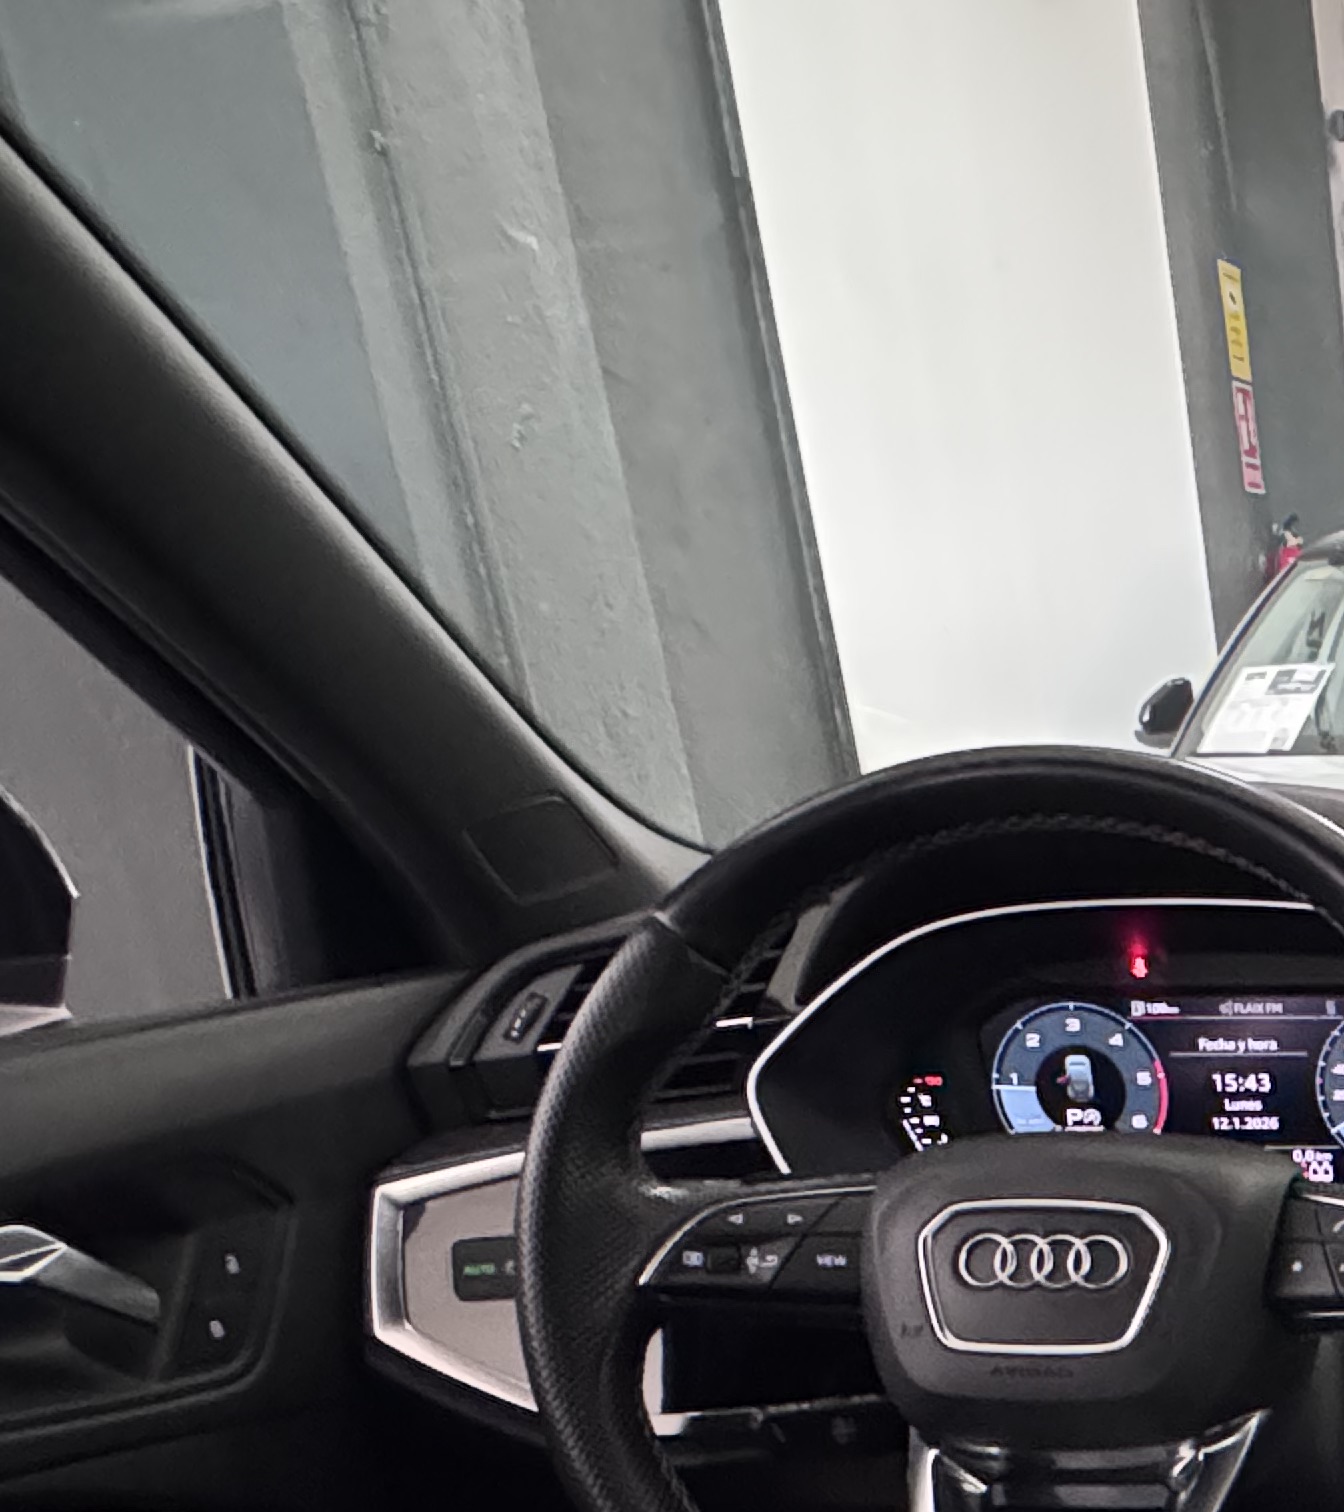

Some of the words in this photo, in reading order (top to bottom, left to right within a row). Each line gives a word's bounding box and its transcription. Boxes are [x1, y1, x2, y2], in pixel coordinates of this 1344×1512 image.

[1266, 1002, 1284, 1014] FM
[1064, 1018, 1081, 1032] 3
[1025, 1032, 1041, 1048] 2
[1108, 1033, 1124, 1047] 4
[1197, 1036, 1236, 1052] Fecha
[1247, 1036, 1278, 1052] hora
[1212, 1073, 1272, 1093] 15:43
[1223, 1098, 1263, 1112] Lunes
[1211, 1116, 1280, 1131] 12.1.2026
